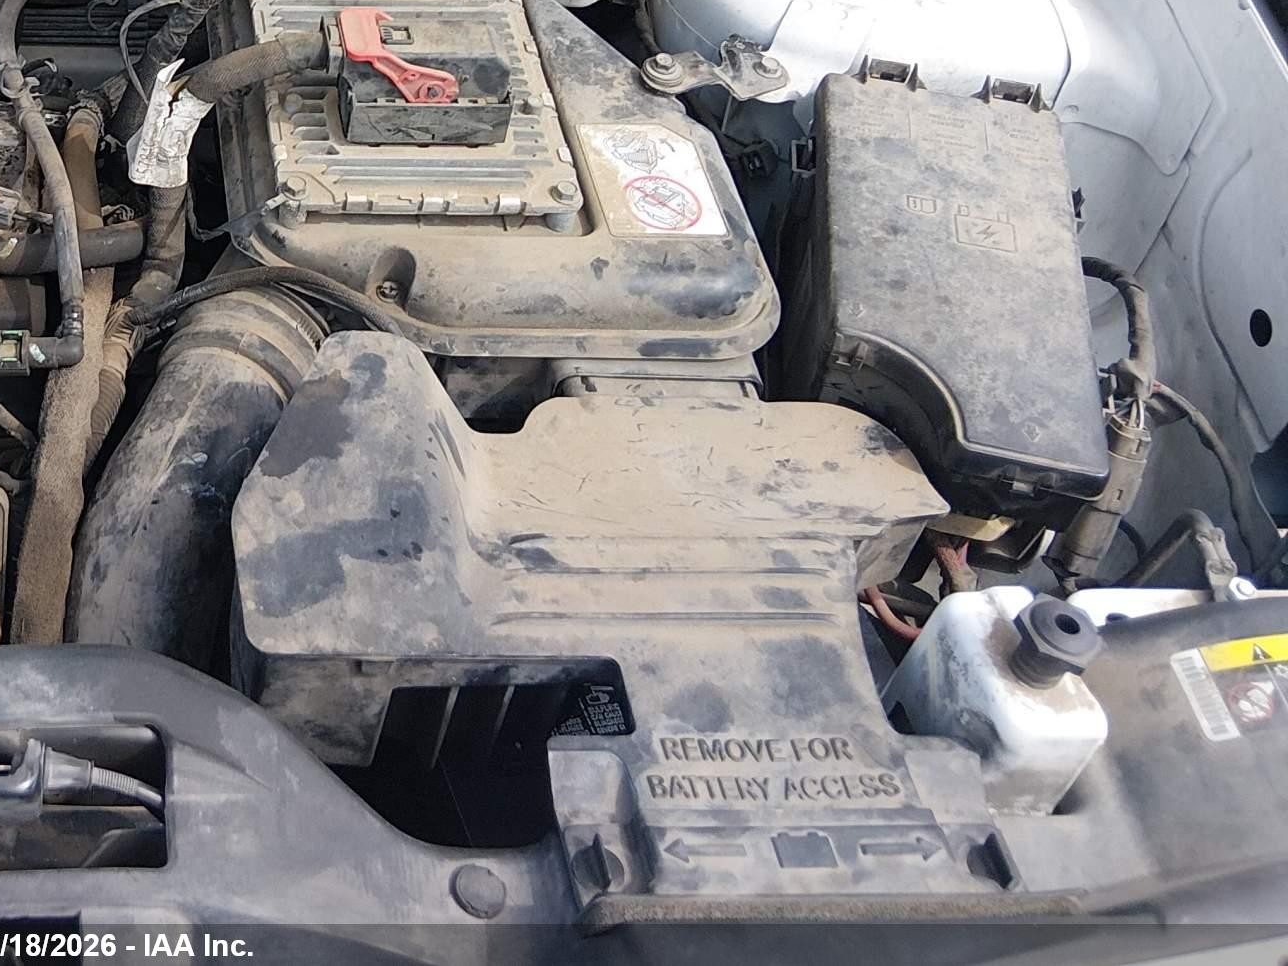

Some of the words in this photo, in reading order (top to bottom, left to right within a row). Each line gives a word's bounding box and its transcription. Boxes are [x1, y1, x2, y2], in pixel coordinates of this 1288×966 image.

[659, 736, 788, 763] REMOVE
[789, 736, 854, 762] FOR
[646, 774, 770, 802] BATTERY
[783, 772, 902, 801] ACCESS
